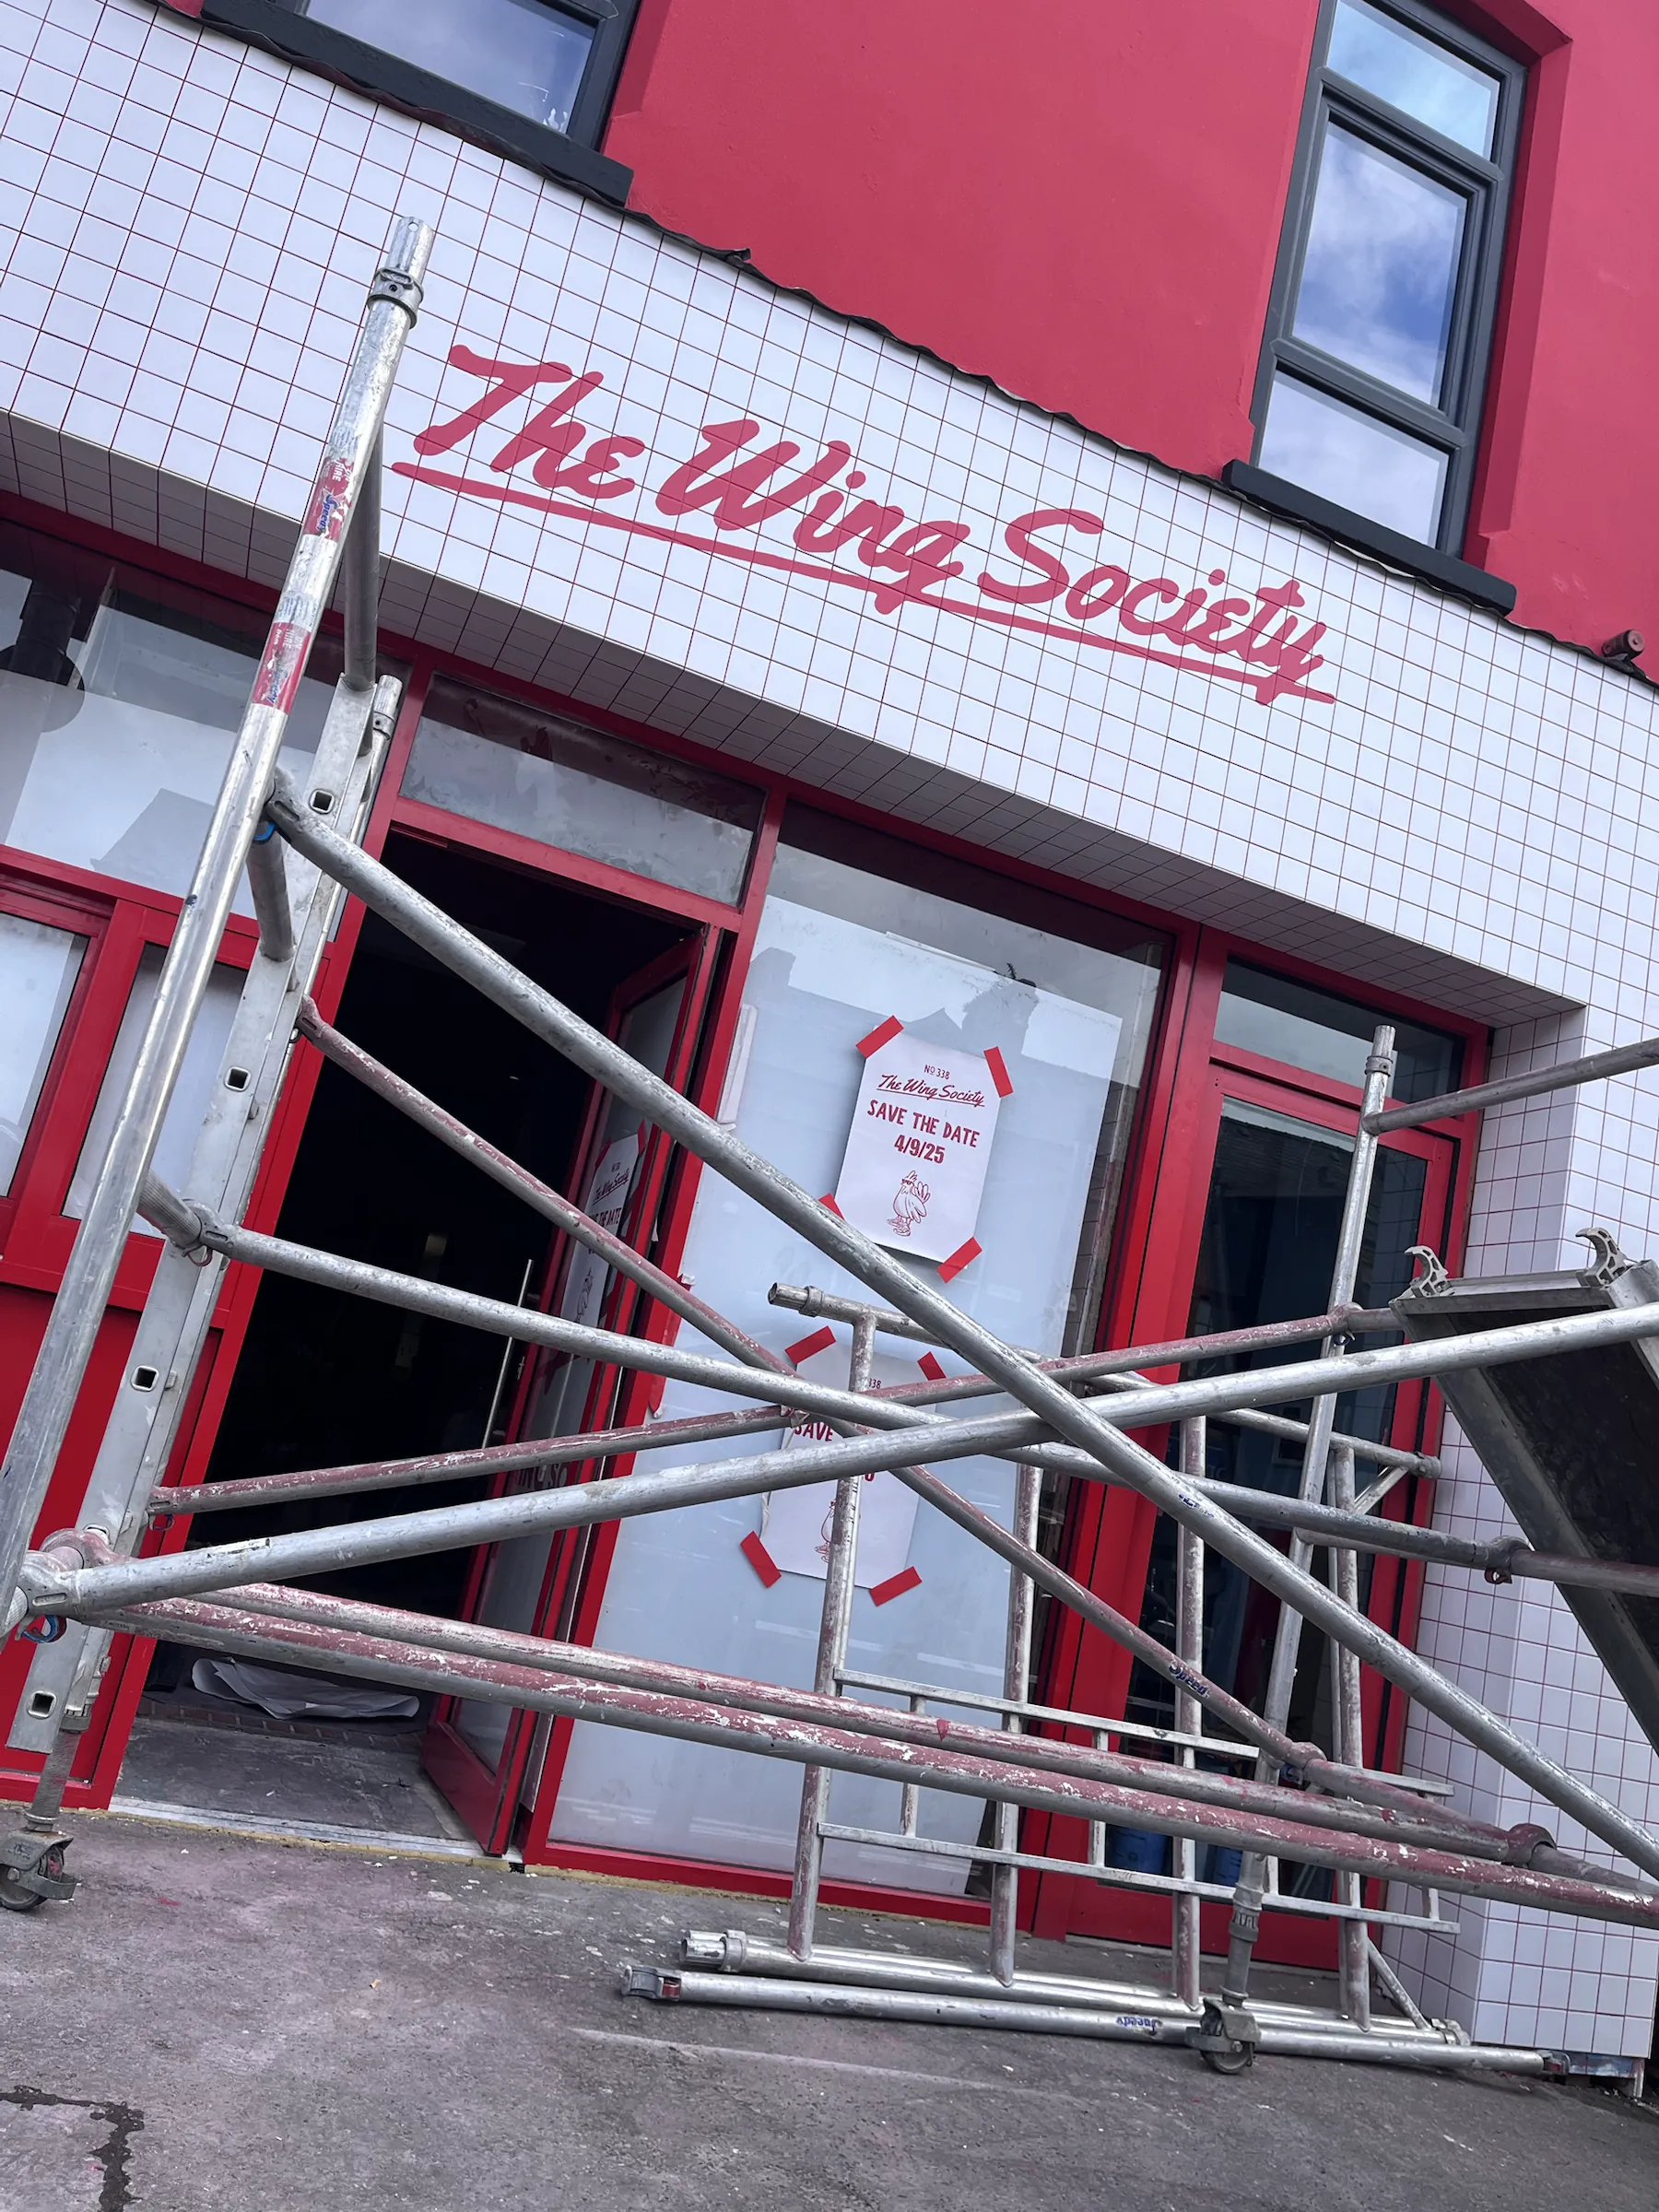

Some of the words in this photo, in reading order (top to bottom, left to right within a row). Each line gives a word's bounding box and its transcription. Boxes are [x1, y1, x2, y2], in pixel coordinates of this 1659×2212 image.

[414, 344, 645, 499] The
[655, 418, 971, 615] Wing
[977, 509, 1326, 704] Society
[936, 1066, 950, 1080] 338
[877, 1074, 901, 1089] The
[904, 1077, 939, 1100] Wing
[938, 1085, 984, 1108] Society
[867, 1100, 908, 1125] SAVE
[912, 1112, 939, 1135] THE
[943, 1122, 981, 1148] DATE
[894, 1135, 946, 1164] 4/9/25
